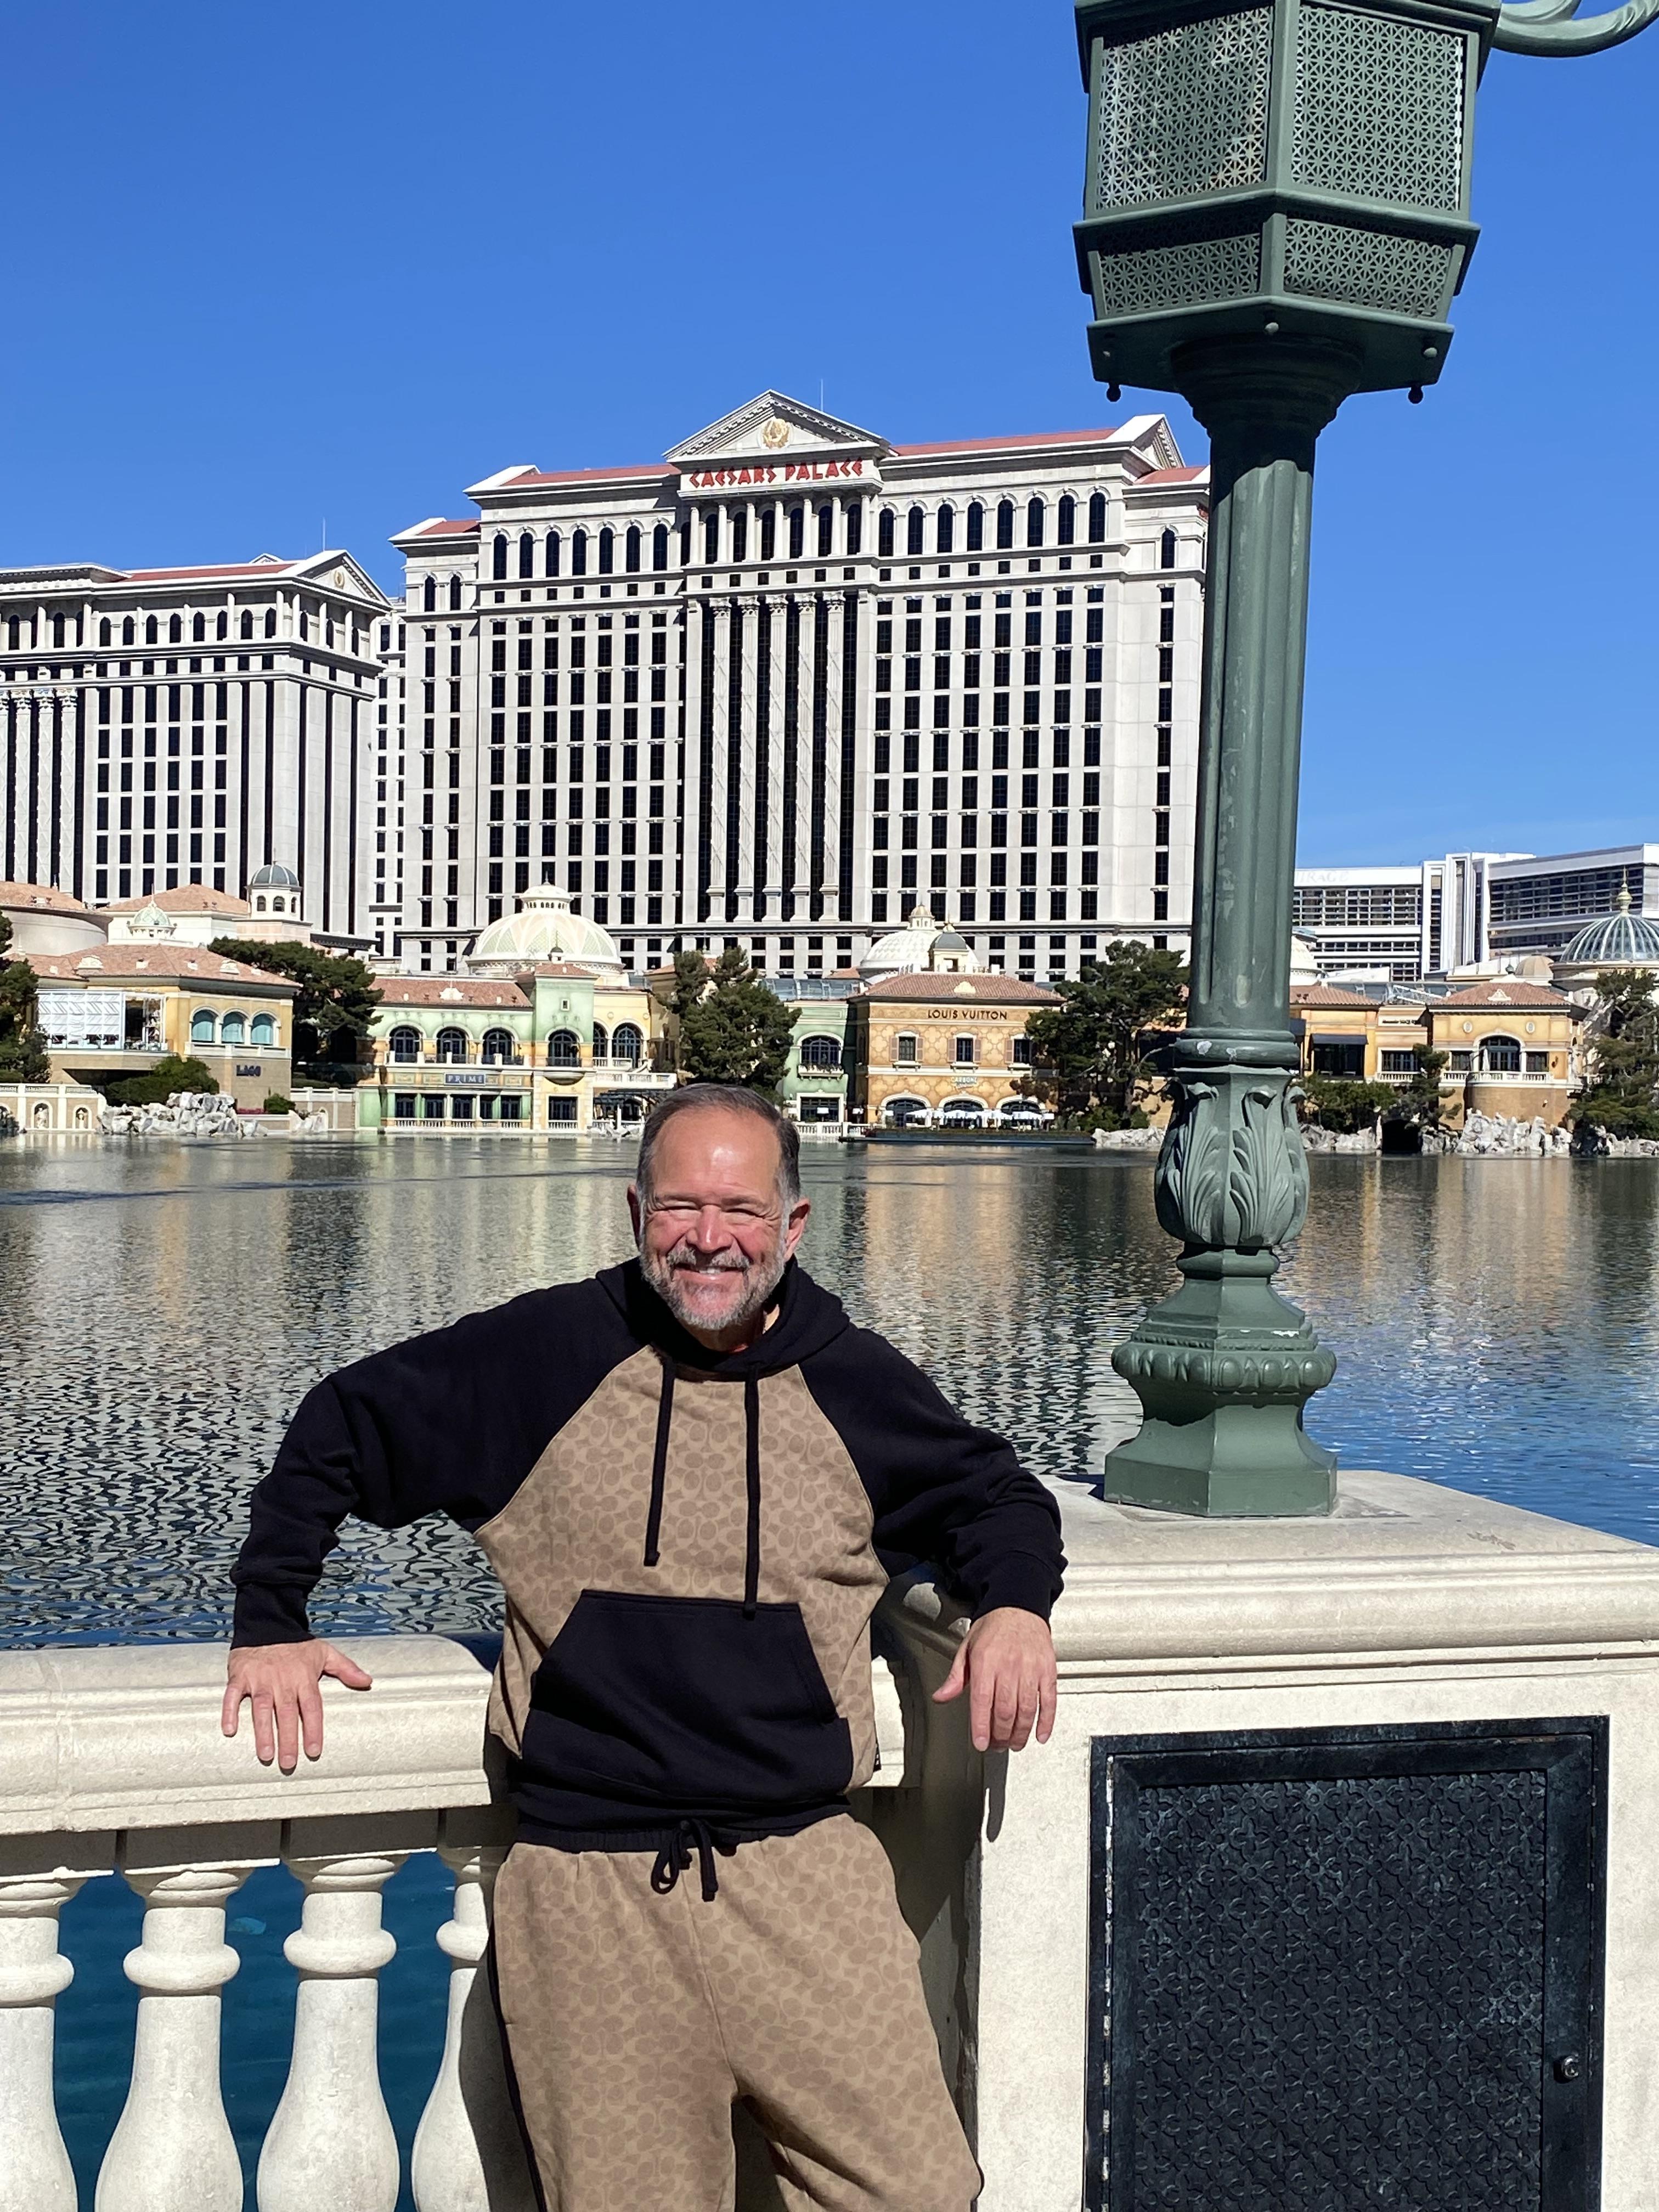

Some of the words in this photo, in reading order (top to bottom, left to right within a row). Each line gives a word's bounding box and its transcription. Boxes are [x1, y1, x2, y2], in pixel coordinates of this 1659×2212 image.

[690, 464, 777, 488] CAESARS
[785, 457, 863, 481] PALACE
[928, 1009, 958, 1019] LOUIS
[962, 1009, 1007, 1020] VUITTON
[448, 1075, 483, 1084] PRIME
